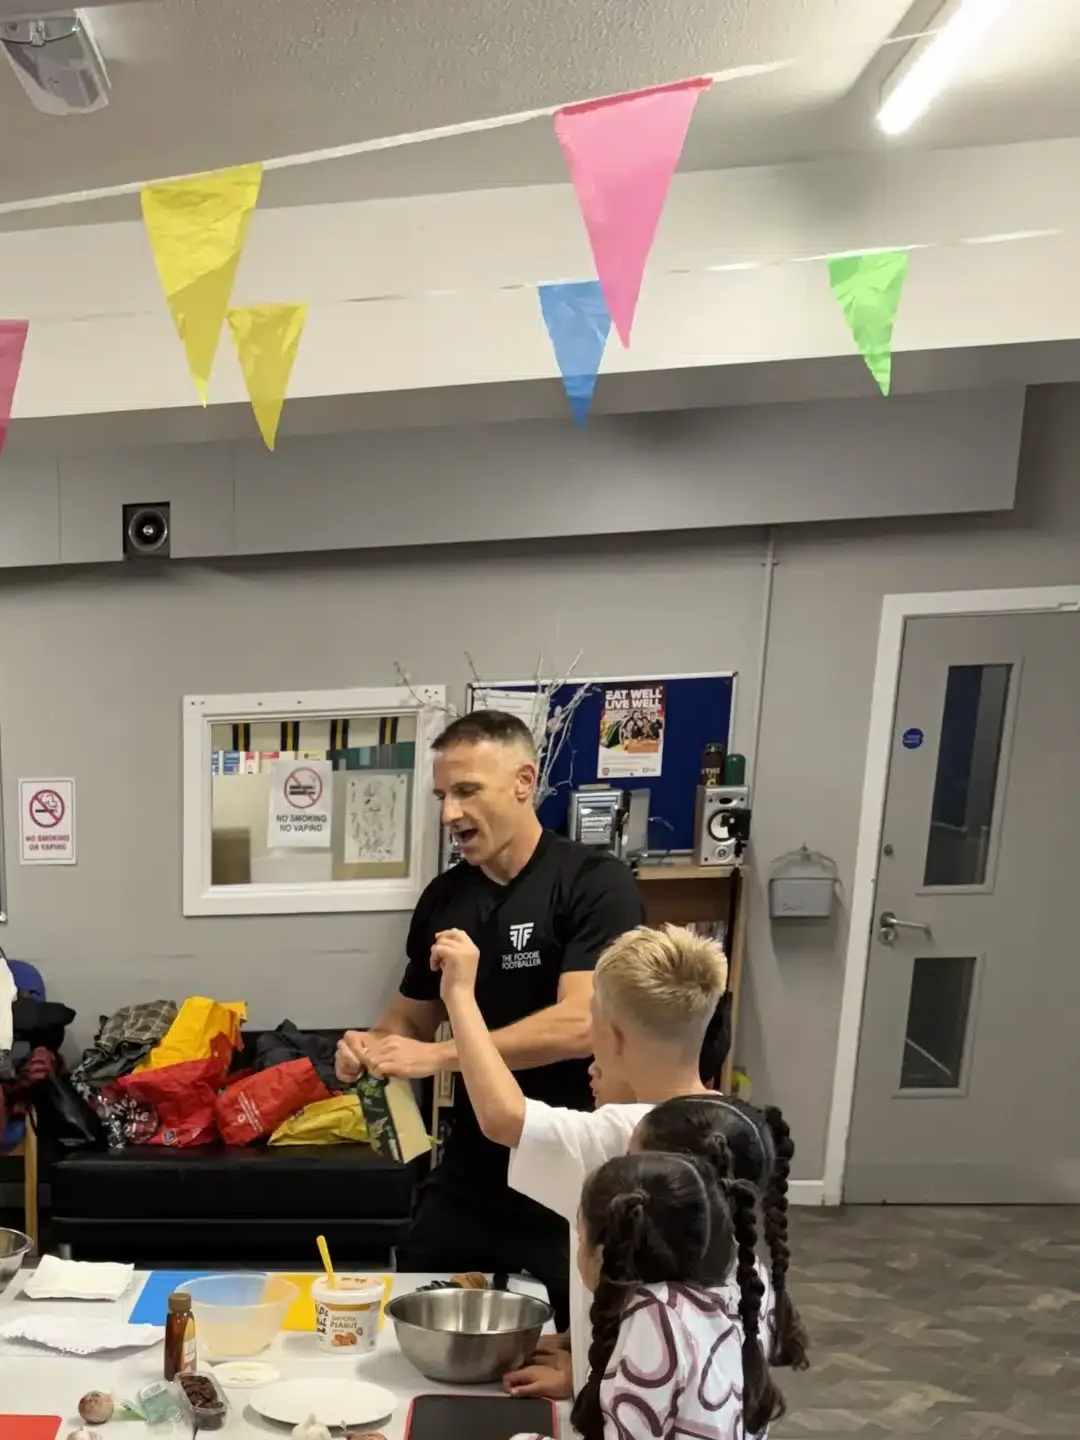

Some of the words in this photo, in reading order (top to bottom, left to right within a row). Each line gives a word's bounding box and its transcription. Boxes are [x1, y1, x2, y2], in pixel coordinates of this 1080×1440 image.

[605, 689, 628, 700] EAT
[630, 687, 662, 699] WELL
[604, 699, 629, 709] LIVE
[631, 698, 661, 708] WELL
[276, 814, 288, 822] NO
[290, 814, 327, 823] SMOKING
[280, 824, 291, 832] NO
[293, 824, 323, 832] VAPING
[38, 834, 70, 842] SMOKING
[41, 843, 67, 851] VAPING
[502, 954, 512, 962] THE
[514, 951, 540, 961] FOODIE
[501, 958, 541, 970] FOOTBALLER
